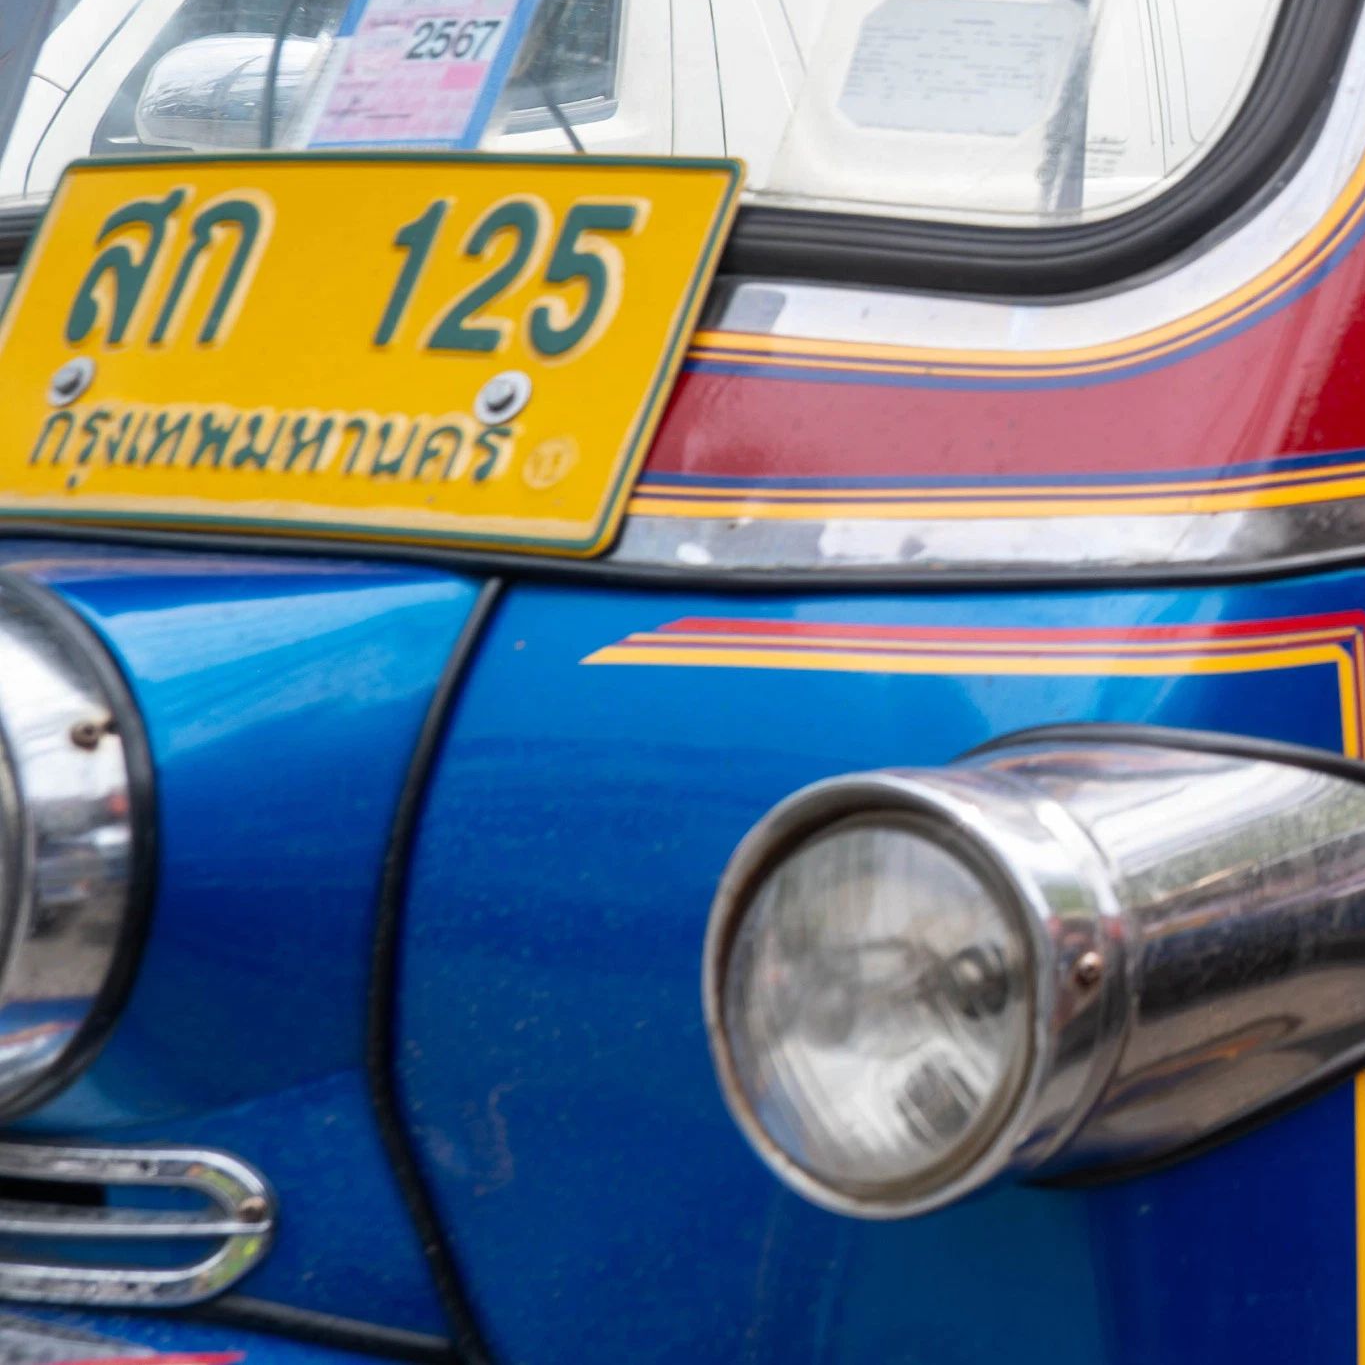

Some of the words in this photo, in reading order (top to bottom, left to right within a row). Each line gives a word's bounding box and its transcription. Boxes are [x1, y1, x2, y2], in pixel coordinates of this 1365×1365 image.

[404, 18, 502, 60] 2567
[63, 187, 264, 347] สก
[372, 198, 640, 356] 125
[29, 408, 515, 489] กรุงเทพมหานคร
